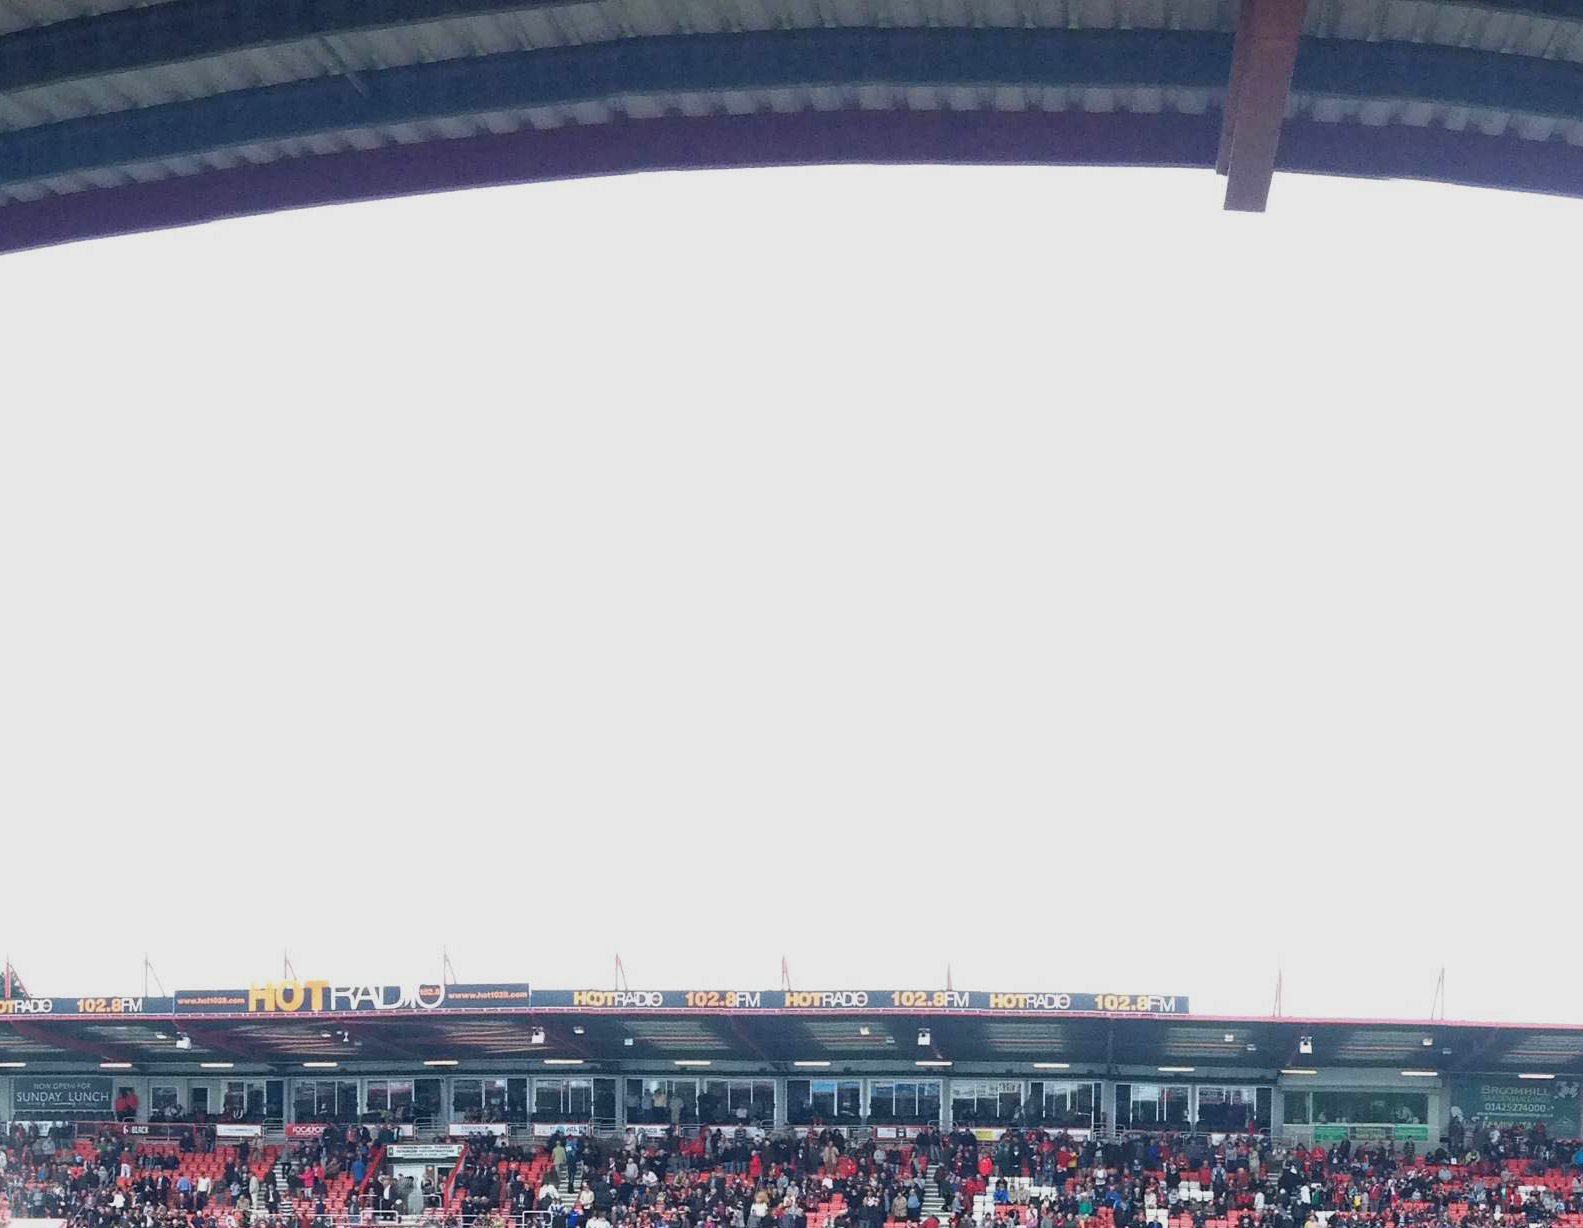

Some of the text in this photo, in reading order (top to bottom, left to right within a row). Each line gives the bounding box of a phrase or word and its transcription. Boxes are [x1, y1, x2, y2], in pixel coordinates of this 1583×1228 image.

[77, 998, 143, 1013] 102.8FM
[892, 991, 970, 1007] 102.8FM
[989, 993, 1175, 1012] HOTRADIO 102.8FM
[16, 1091, 110, 1102] SUNDAY LUNCH
